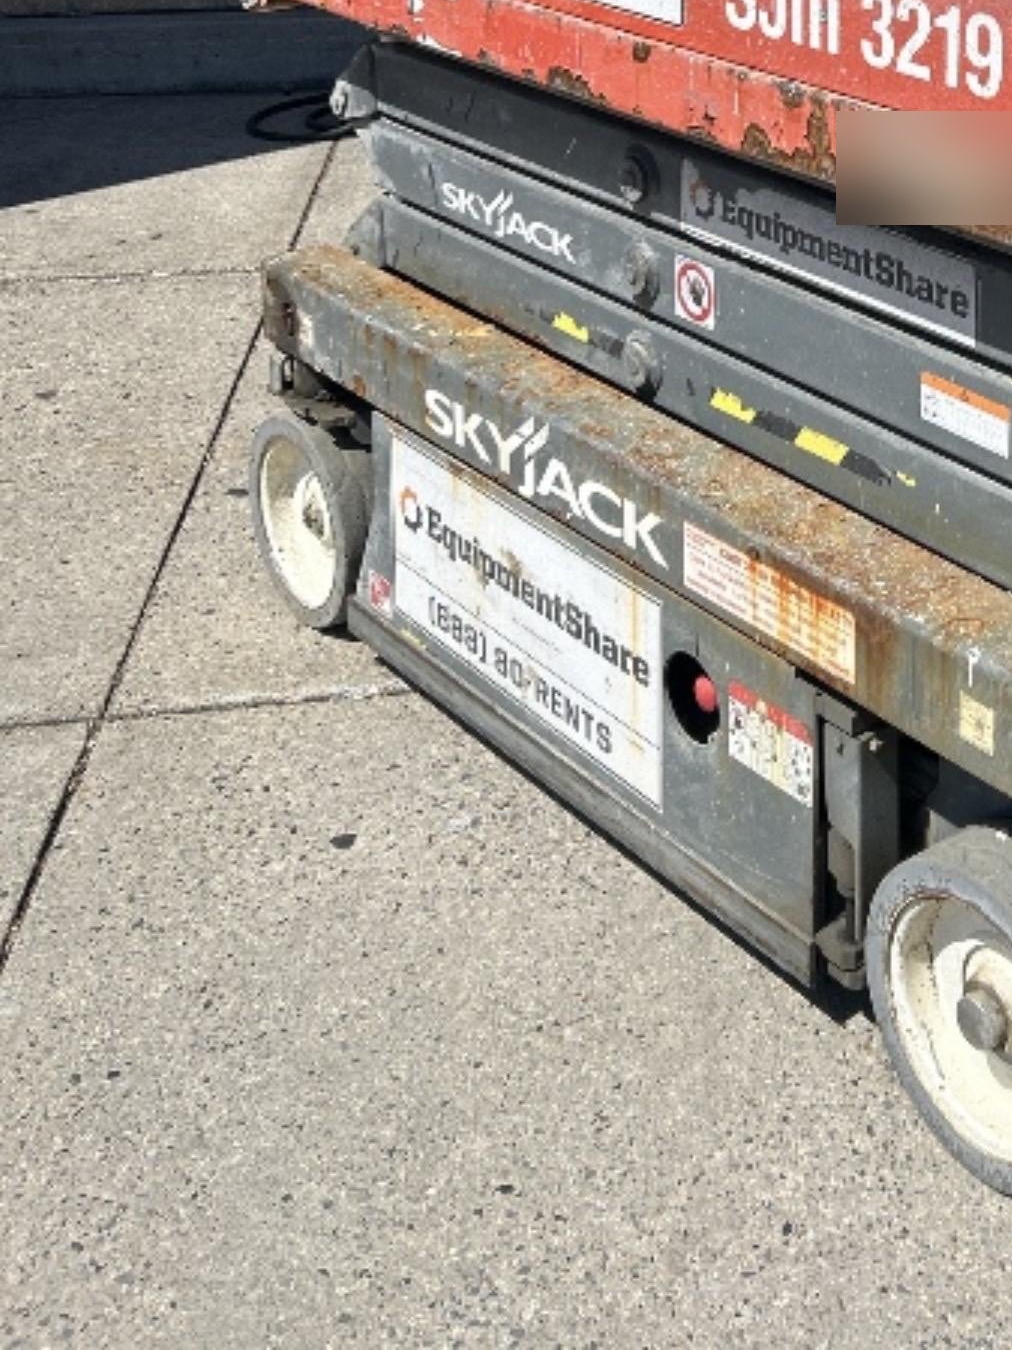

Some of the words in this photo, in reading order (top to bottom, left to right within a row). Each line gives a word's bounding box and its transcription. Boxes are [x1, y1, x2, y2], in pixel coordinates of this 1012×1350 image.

[441, 181, 577, 265] SKYJACK
[721, 194, 971, 319] EquipmentShare
[423, 387, 671, 570] SKYJACK
[427, 505, 651, 688] EquipmentShare
